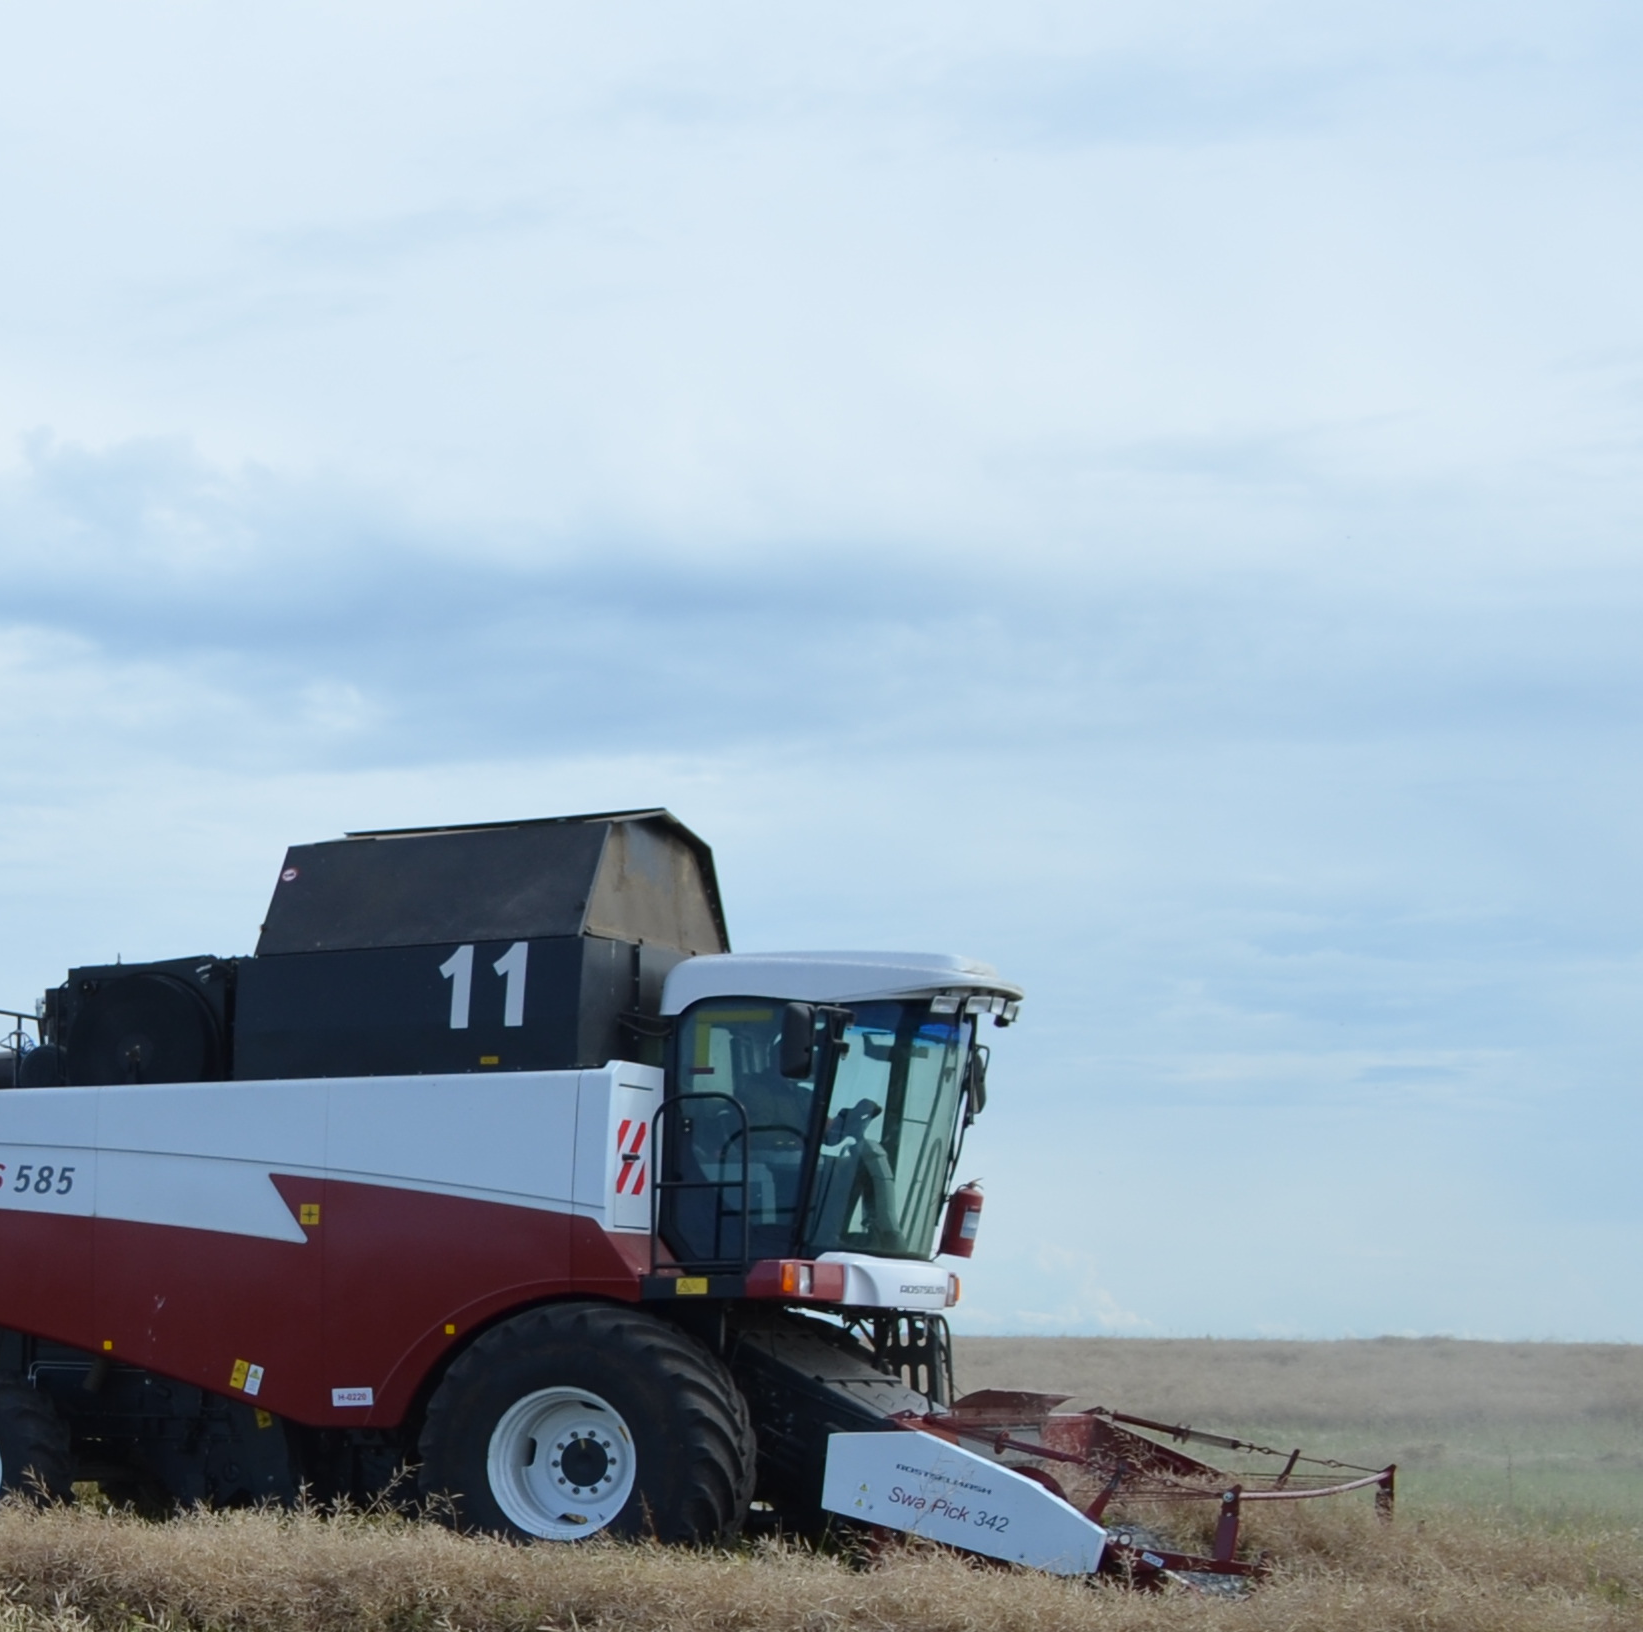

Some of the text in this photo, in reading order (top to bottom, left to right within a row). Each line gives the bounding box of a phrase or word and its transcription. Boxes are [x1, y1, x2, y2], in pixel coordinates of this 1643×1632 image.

[438, 941, 529, 1029] 11
[13, 1164, 76, 1195] 585
[888, 1486, 1010, 1534] Swa Pick 342
